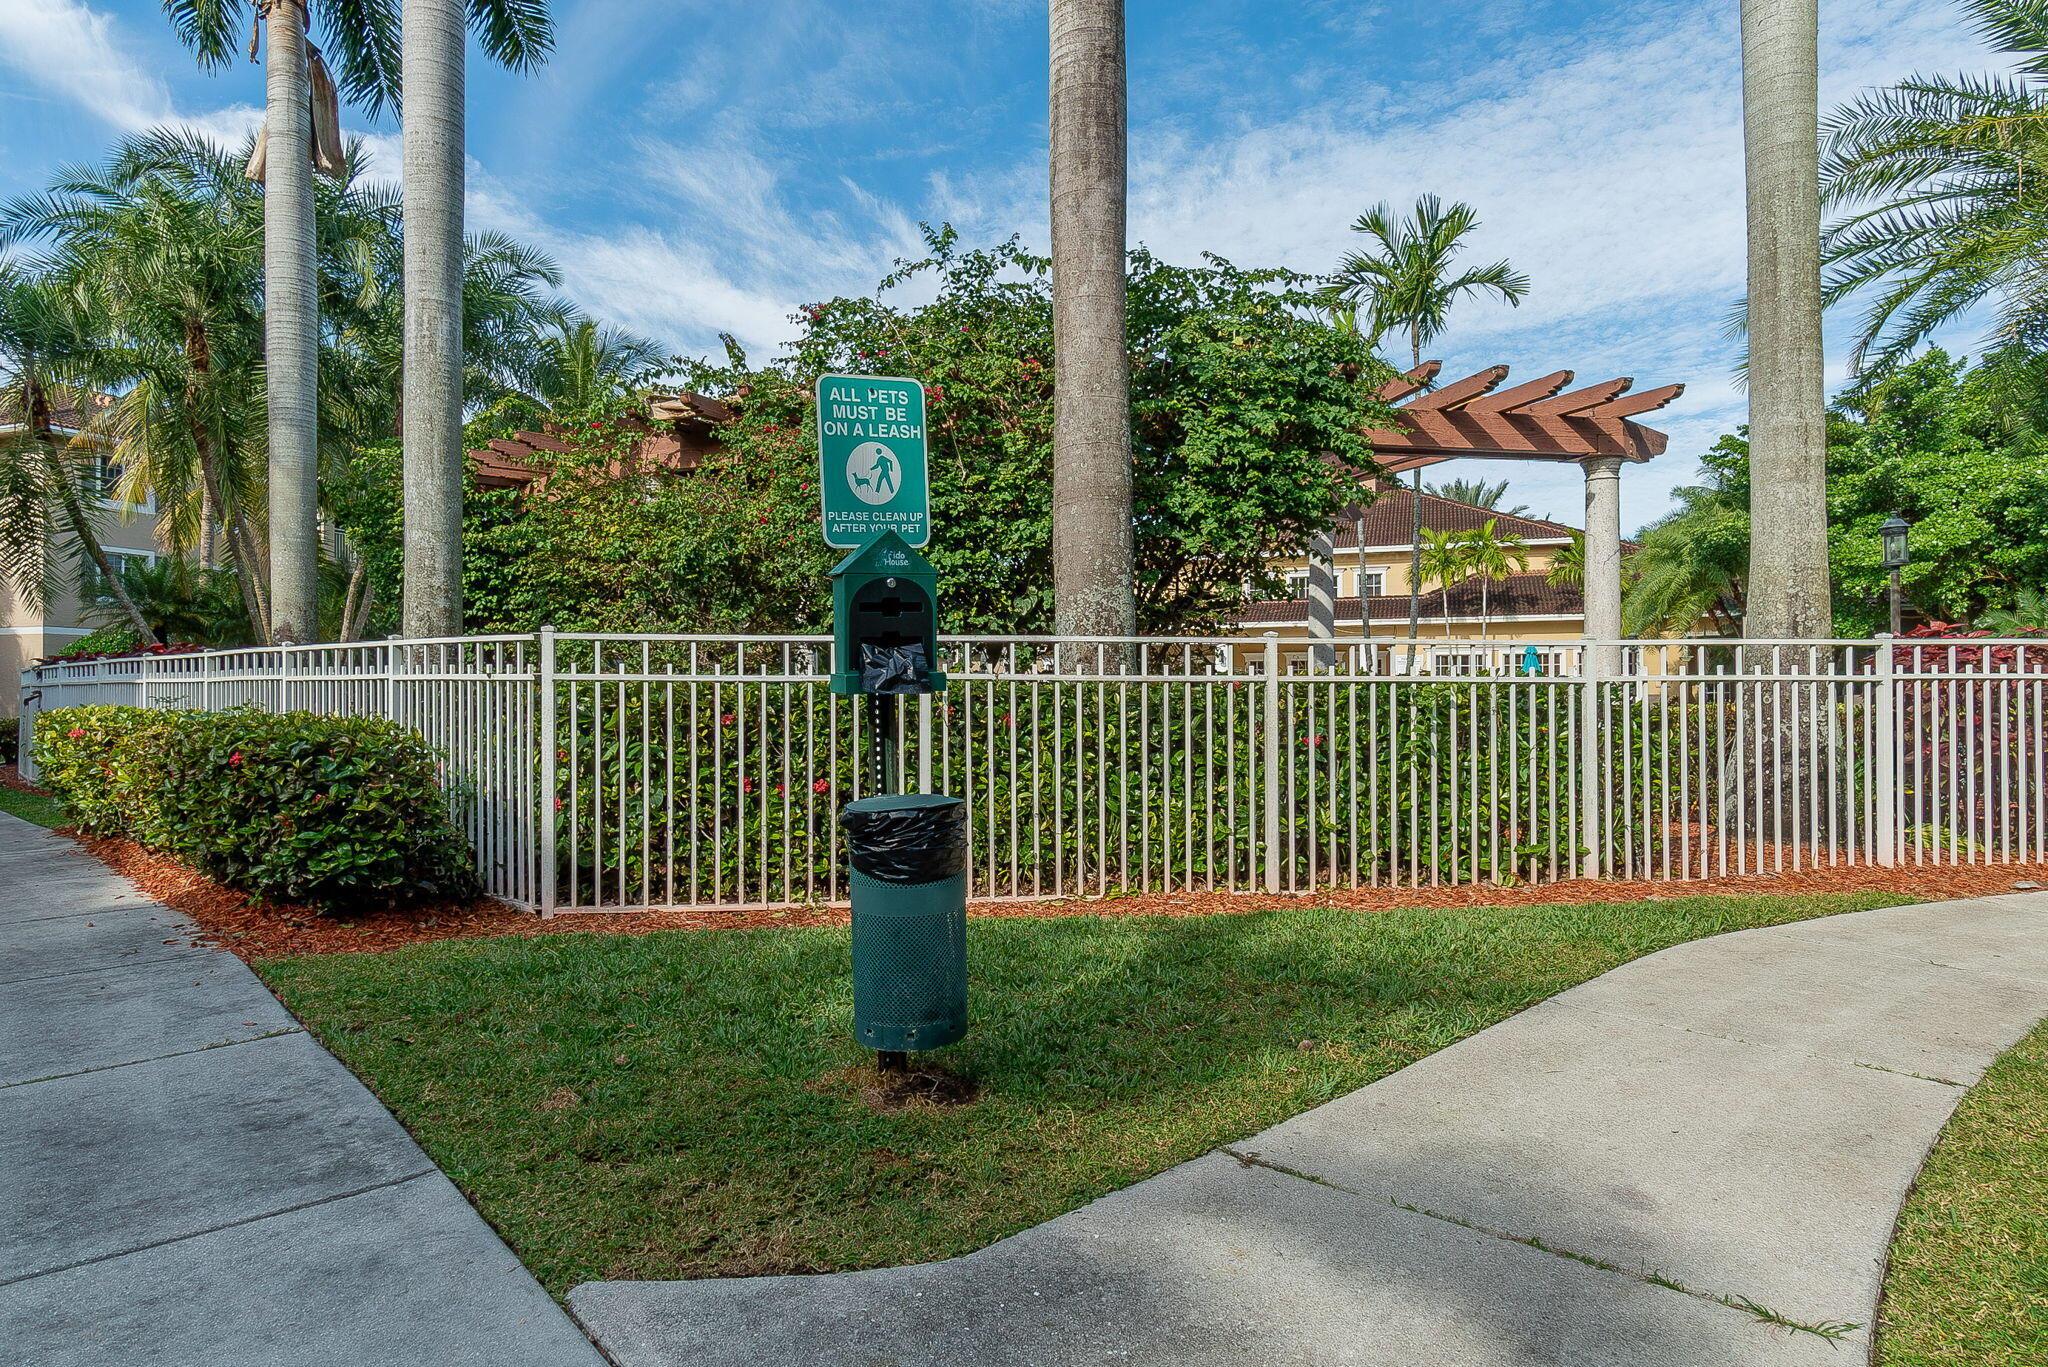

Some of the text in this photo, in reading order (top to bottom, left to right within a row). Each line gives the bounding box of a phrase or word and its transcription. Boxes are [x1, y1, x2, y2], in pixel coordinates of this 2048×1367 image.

[829, 387, 909, 405] ALL PETS
[832, 404, 907, 421] MUST BE
[824, 421, 921, 439] ON A LEASH
[828, 511, 923, 521] PLEASE CLEAN UP
[832, 523, 866, 533] AFTER
[901, 524, 921, 533] PET
